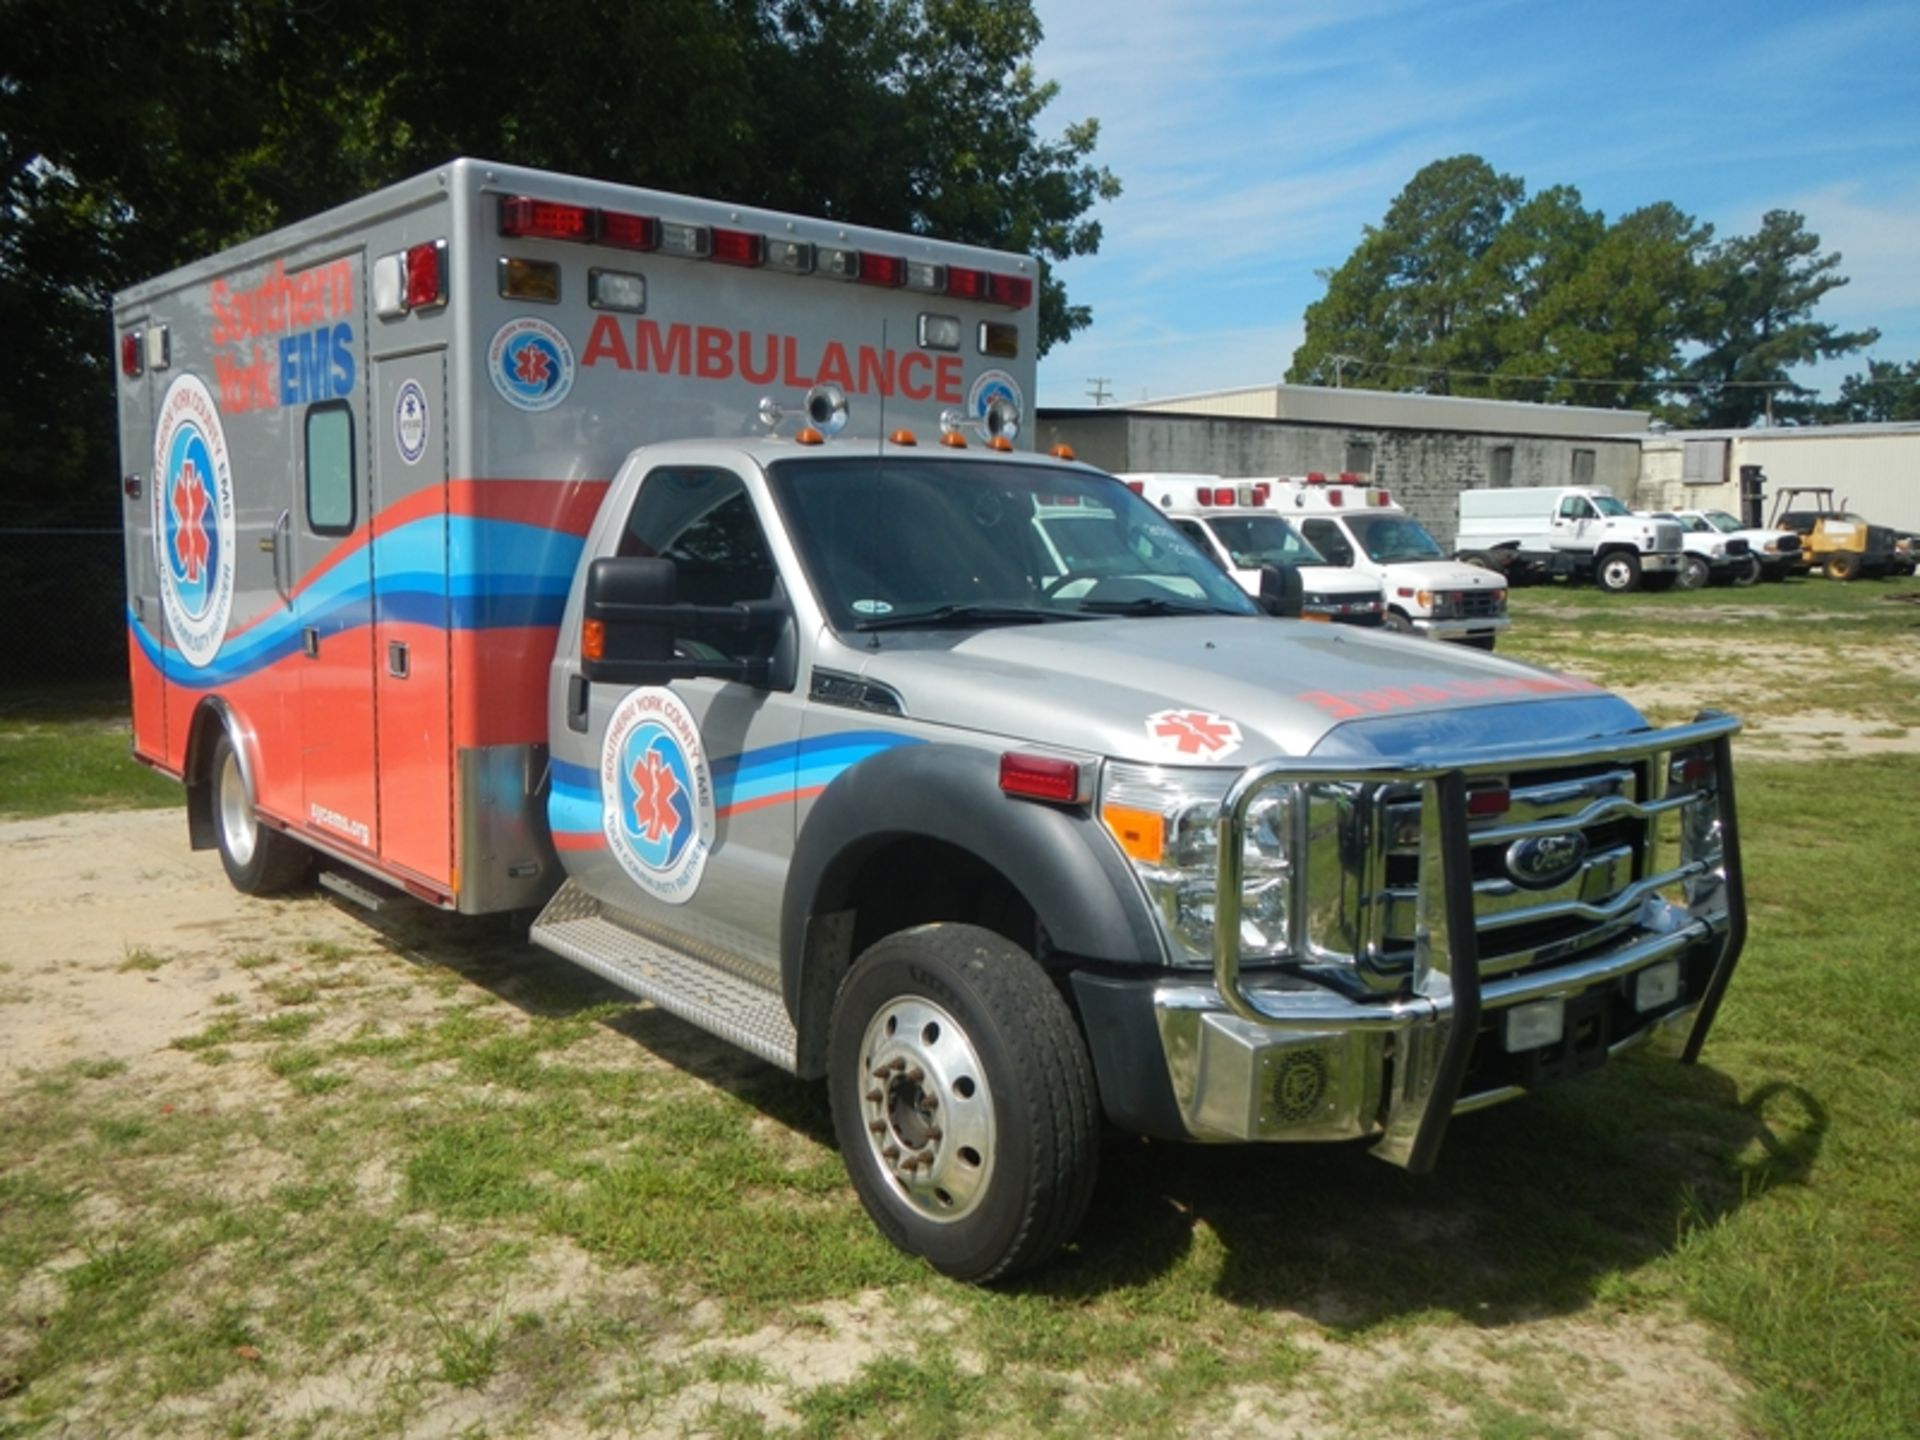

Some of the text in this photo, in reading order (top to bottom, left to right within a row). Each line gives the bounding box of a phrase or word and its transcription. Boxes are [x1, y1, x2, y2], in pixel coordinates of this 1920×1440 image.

[211, 258, 353, 346] Southern
[213, 321, 356, 416] York EMS
[581, 314, 964, 404] AMBULANCE
[218, 460, 232, 520] EMS
[604, 695, 711, 809] SOUTHERN YORK COUNTY EMS
